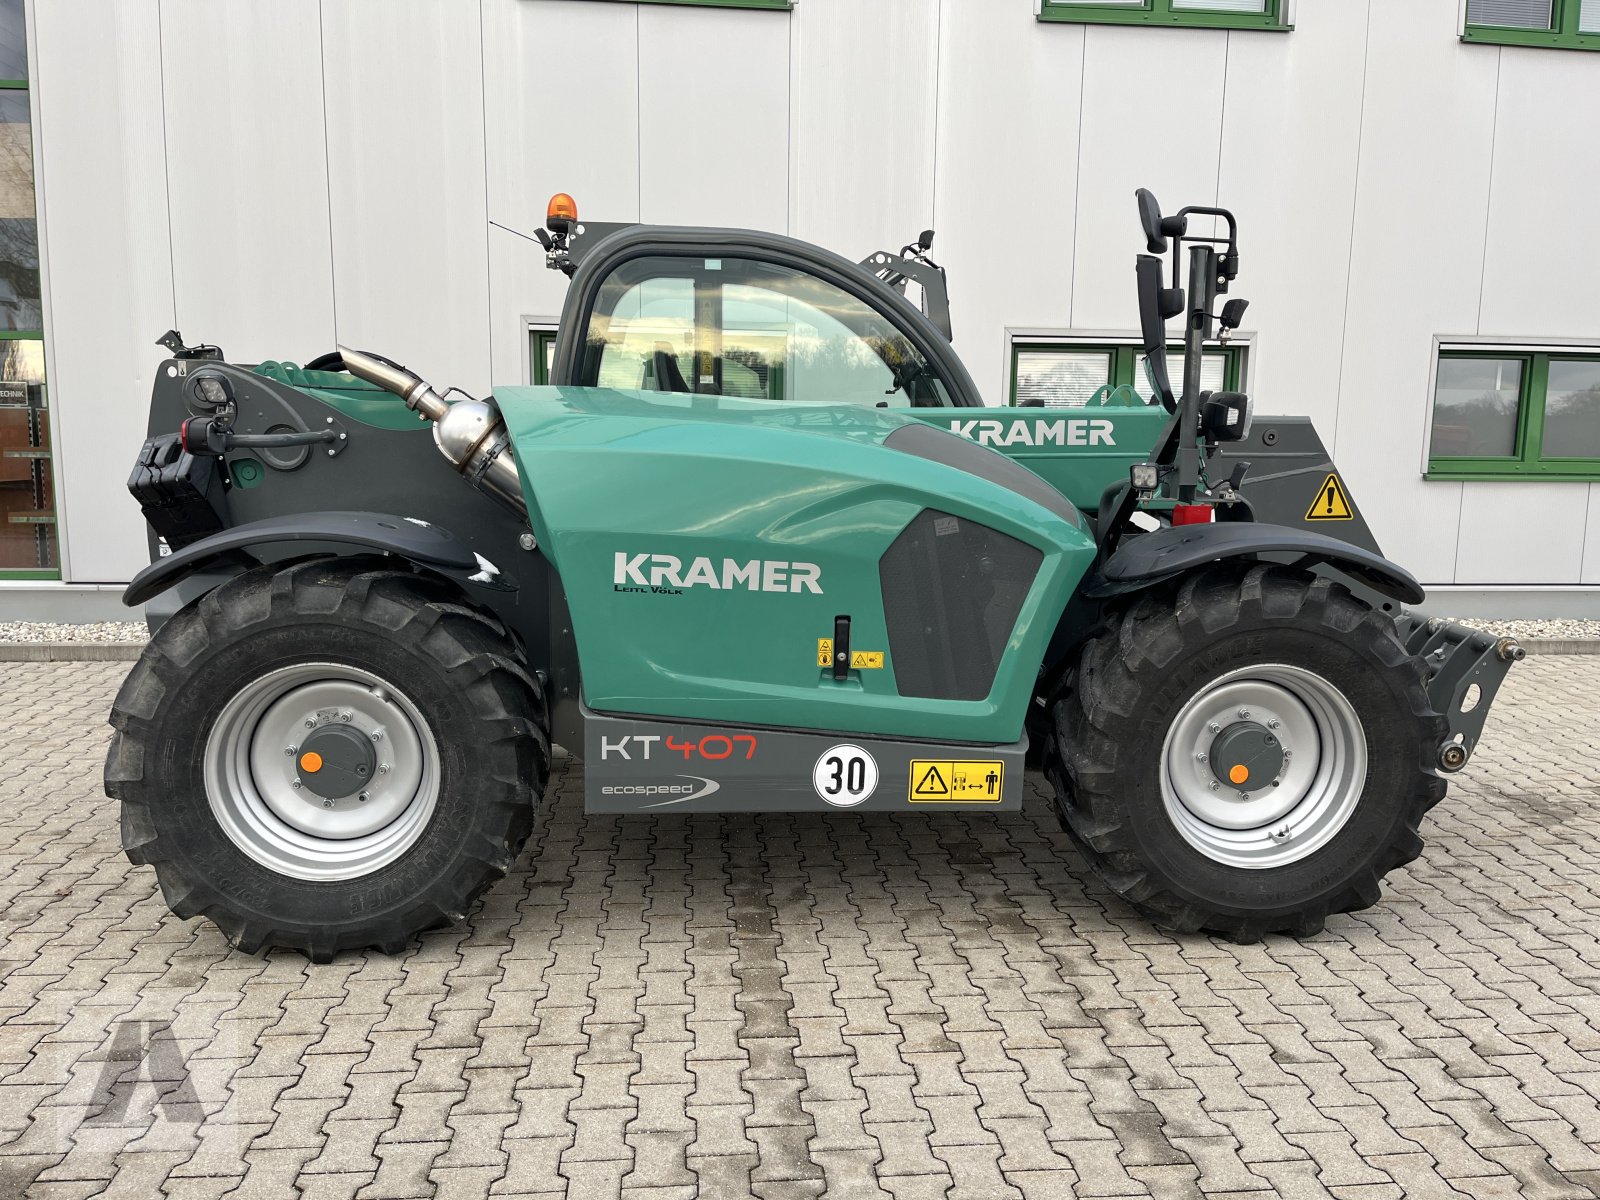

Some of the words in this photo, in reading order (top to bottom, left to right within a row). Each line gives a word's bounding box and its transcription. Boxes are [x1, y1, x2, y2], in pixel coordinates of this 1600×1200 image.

[0, 390, 24, 398] ECHNIK
[950, 419, 1117, 446] KRAMER
[614, 551, 824, 594] KRAMER
[601, 783, 693, 796] ecospeed
[824, 756, 866, 796] 30
